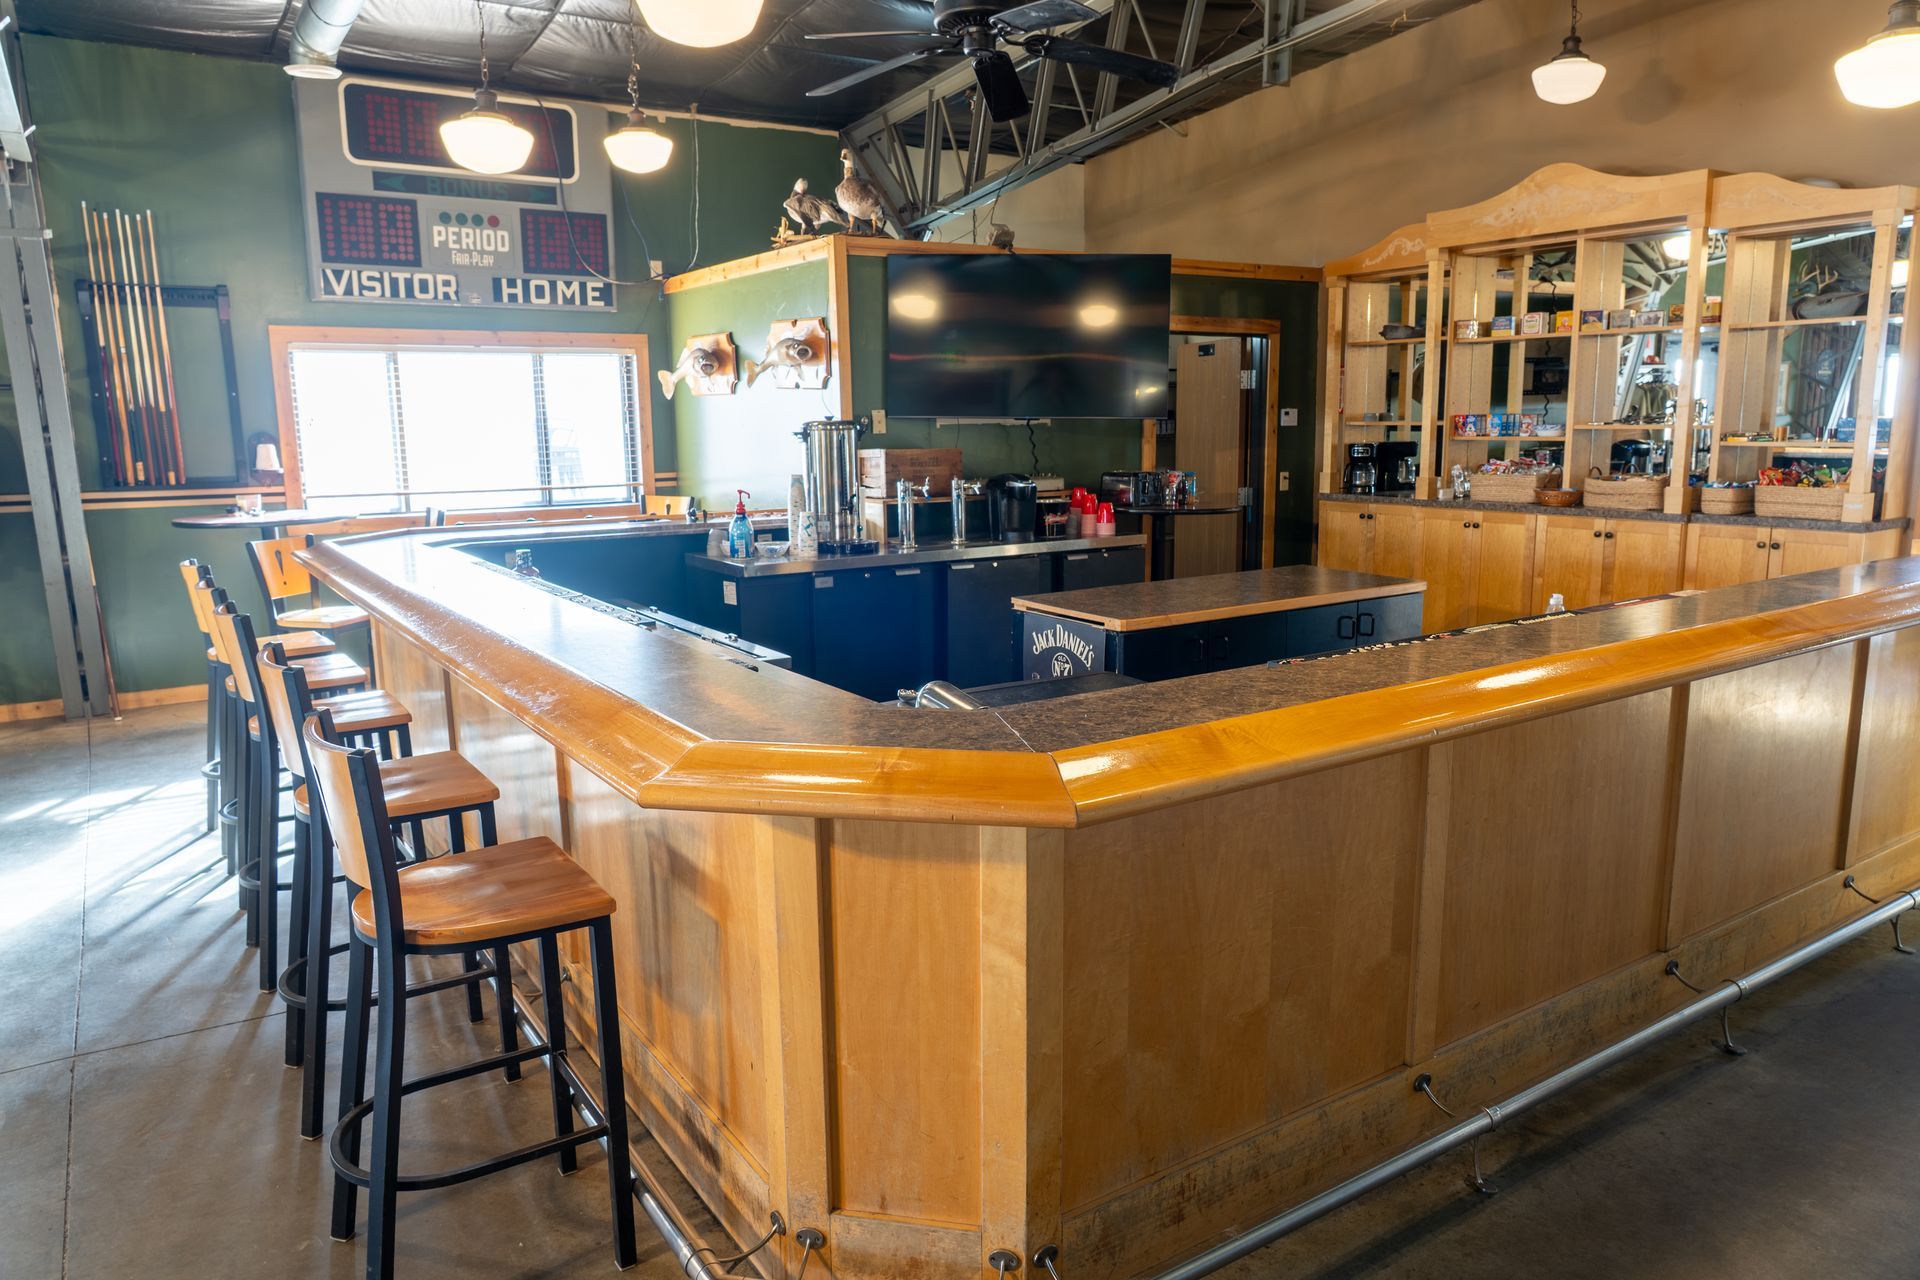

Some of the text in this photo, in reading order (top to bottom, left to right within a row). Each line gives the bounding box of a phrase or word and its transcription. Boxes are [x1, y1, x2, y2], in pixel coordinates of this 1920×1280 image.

[433, 226, 509, 252] PERIOD
[324, 269, 458, 301] VISITOR
[501, 278, 604, 306] HOME
[1032, 629, 1056, 655] JACK
